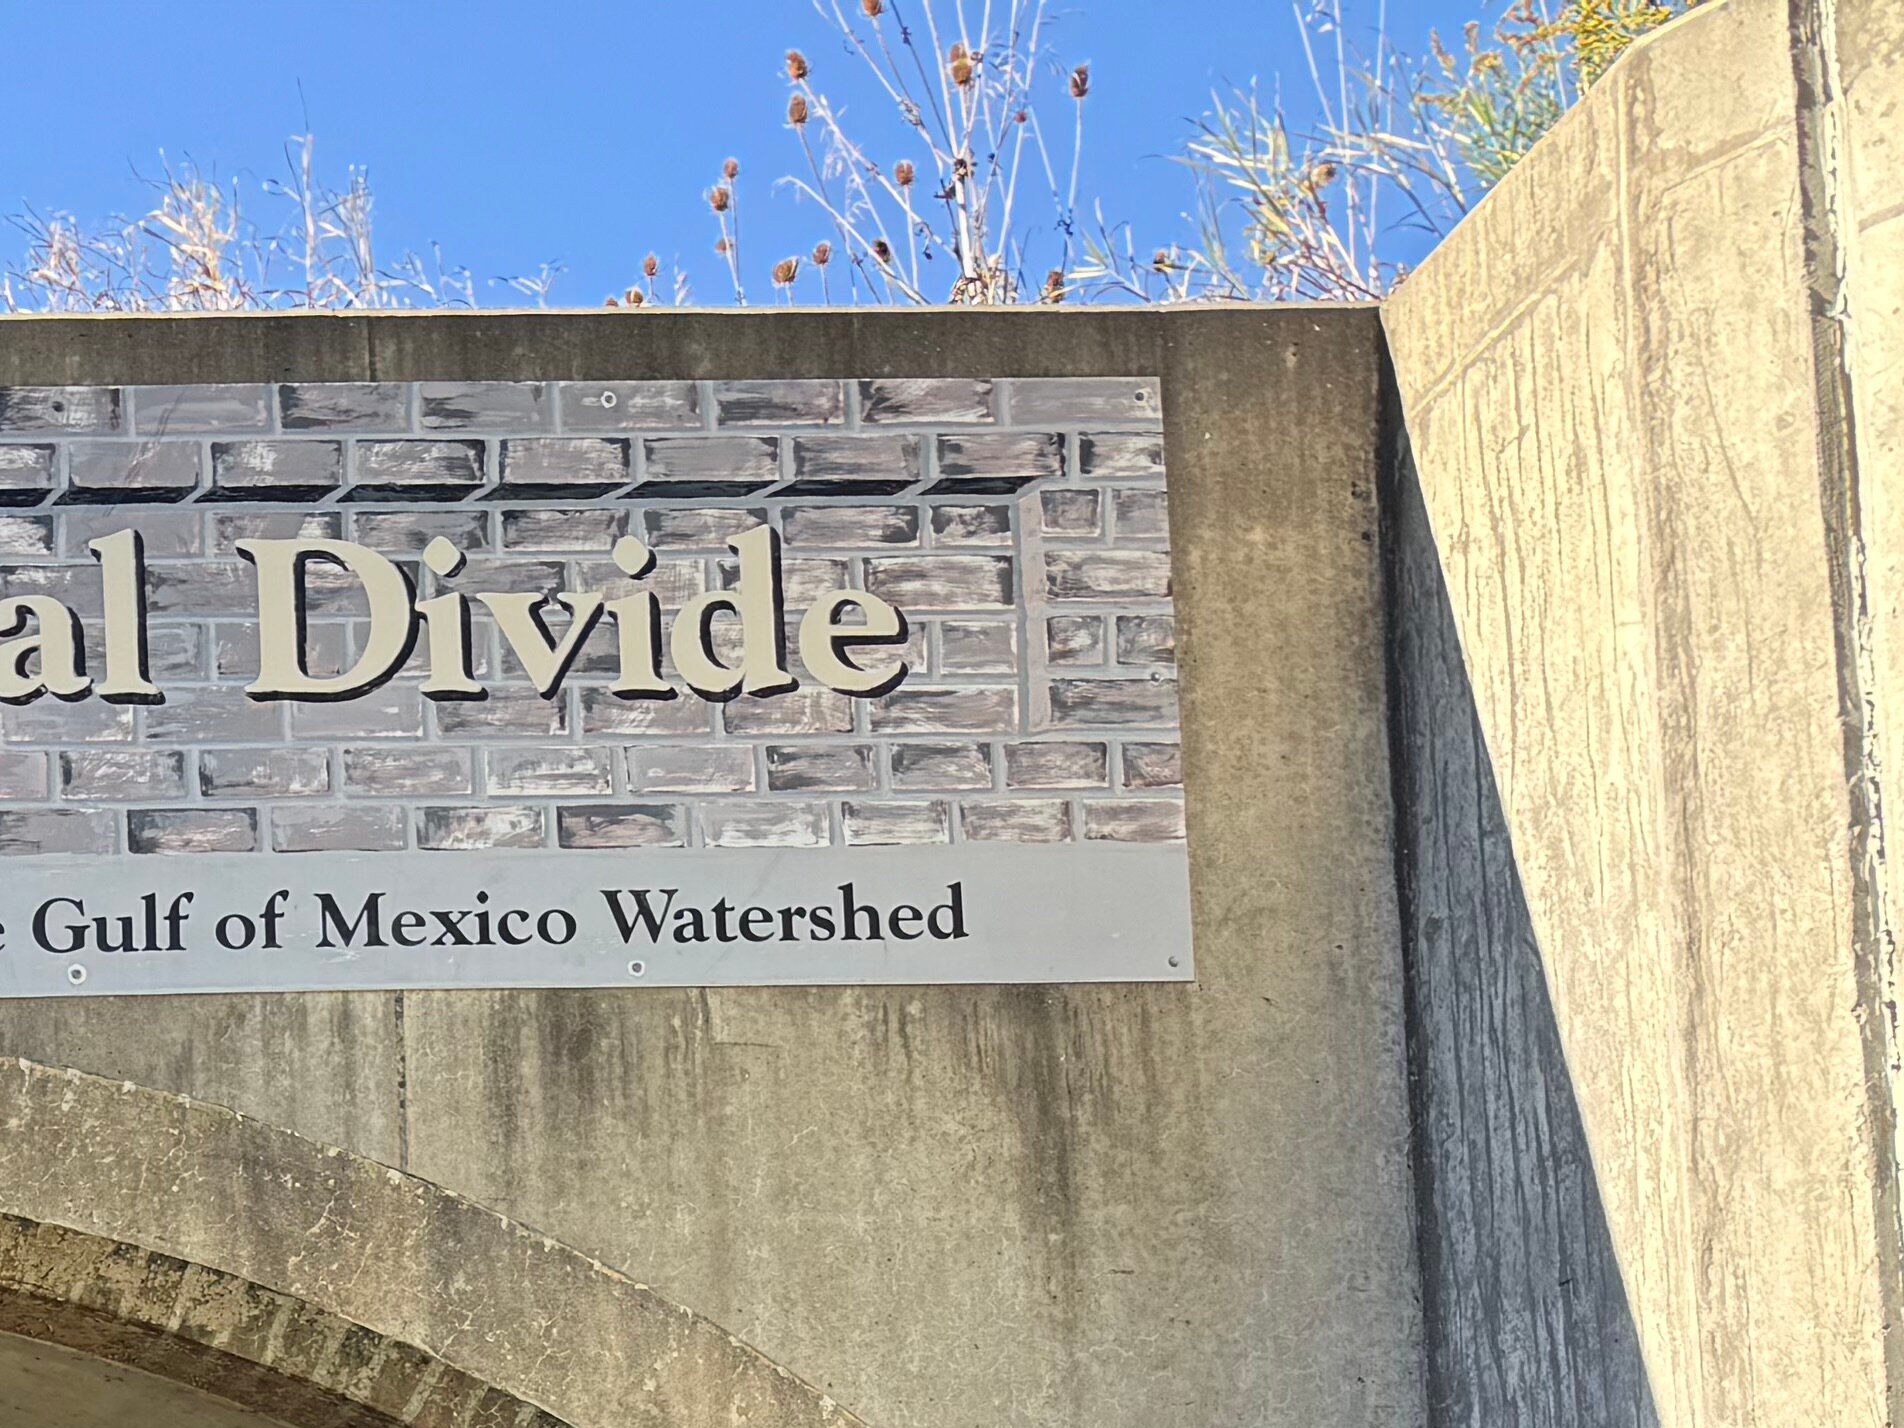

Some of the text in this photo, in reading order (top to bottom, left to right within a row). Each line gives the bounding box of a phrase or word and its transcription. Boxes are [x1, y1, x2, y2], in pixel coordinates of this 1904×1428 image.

[238, 527, 910, 706] Divide
[31, 886, 192, 955] Gulf
[215, 888, 291, 949] of
[314, 888, 579, 950] Mexico
[598, 880, 968, 950] Watershed
